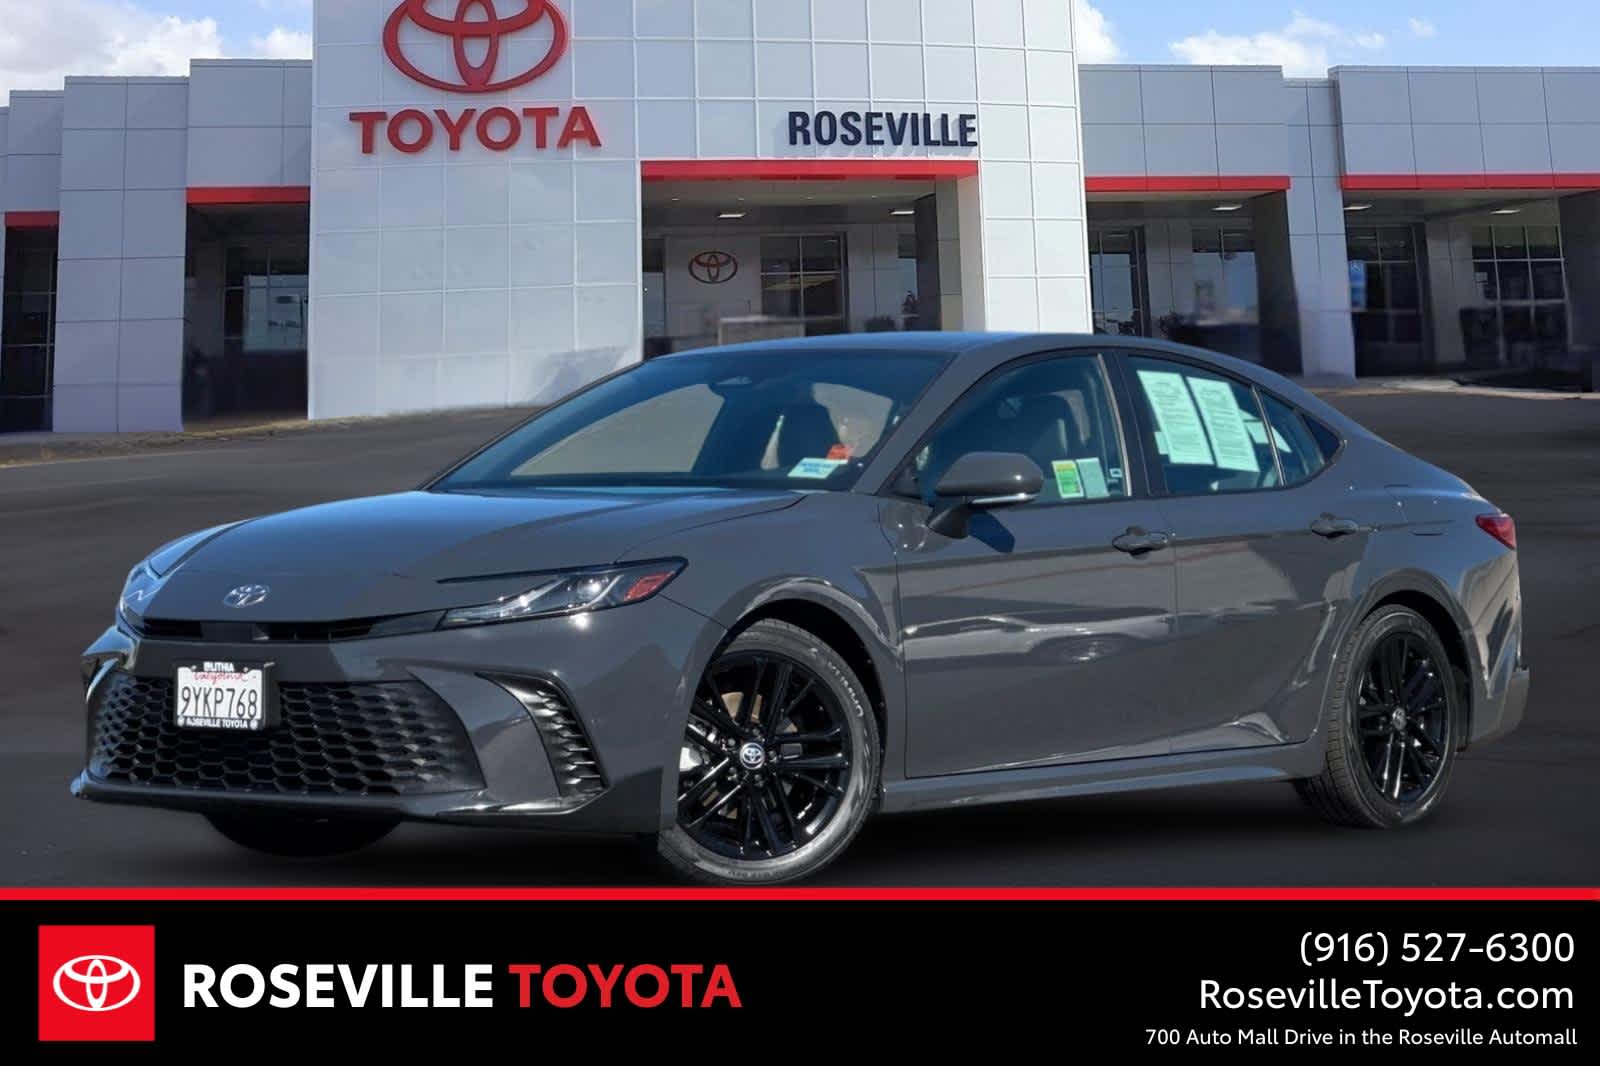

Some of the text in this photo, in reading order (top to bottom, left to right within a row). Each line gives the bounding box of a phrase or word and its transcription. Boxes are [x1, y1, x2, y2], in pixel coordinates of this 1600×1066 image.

[349, 106, 601, 154] TOYOTA
[788, 111, 978, 147] ROSEVILLE
[181, 686, 257, 718] 9YKP768
